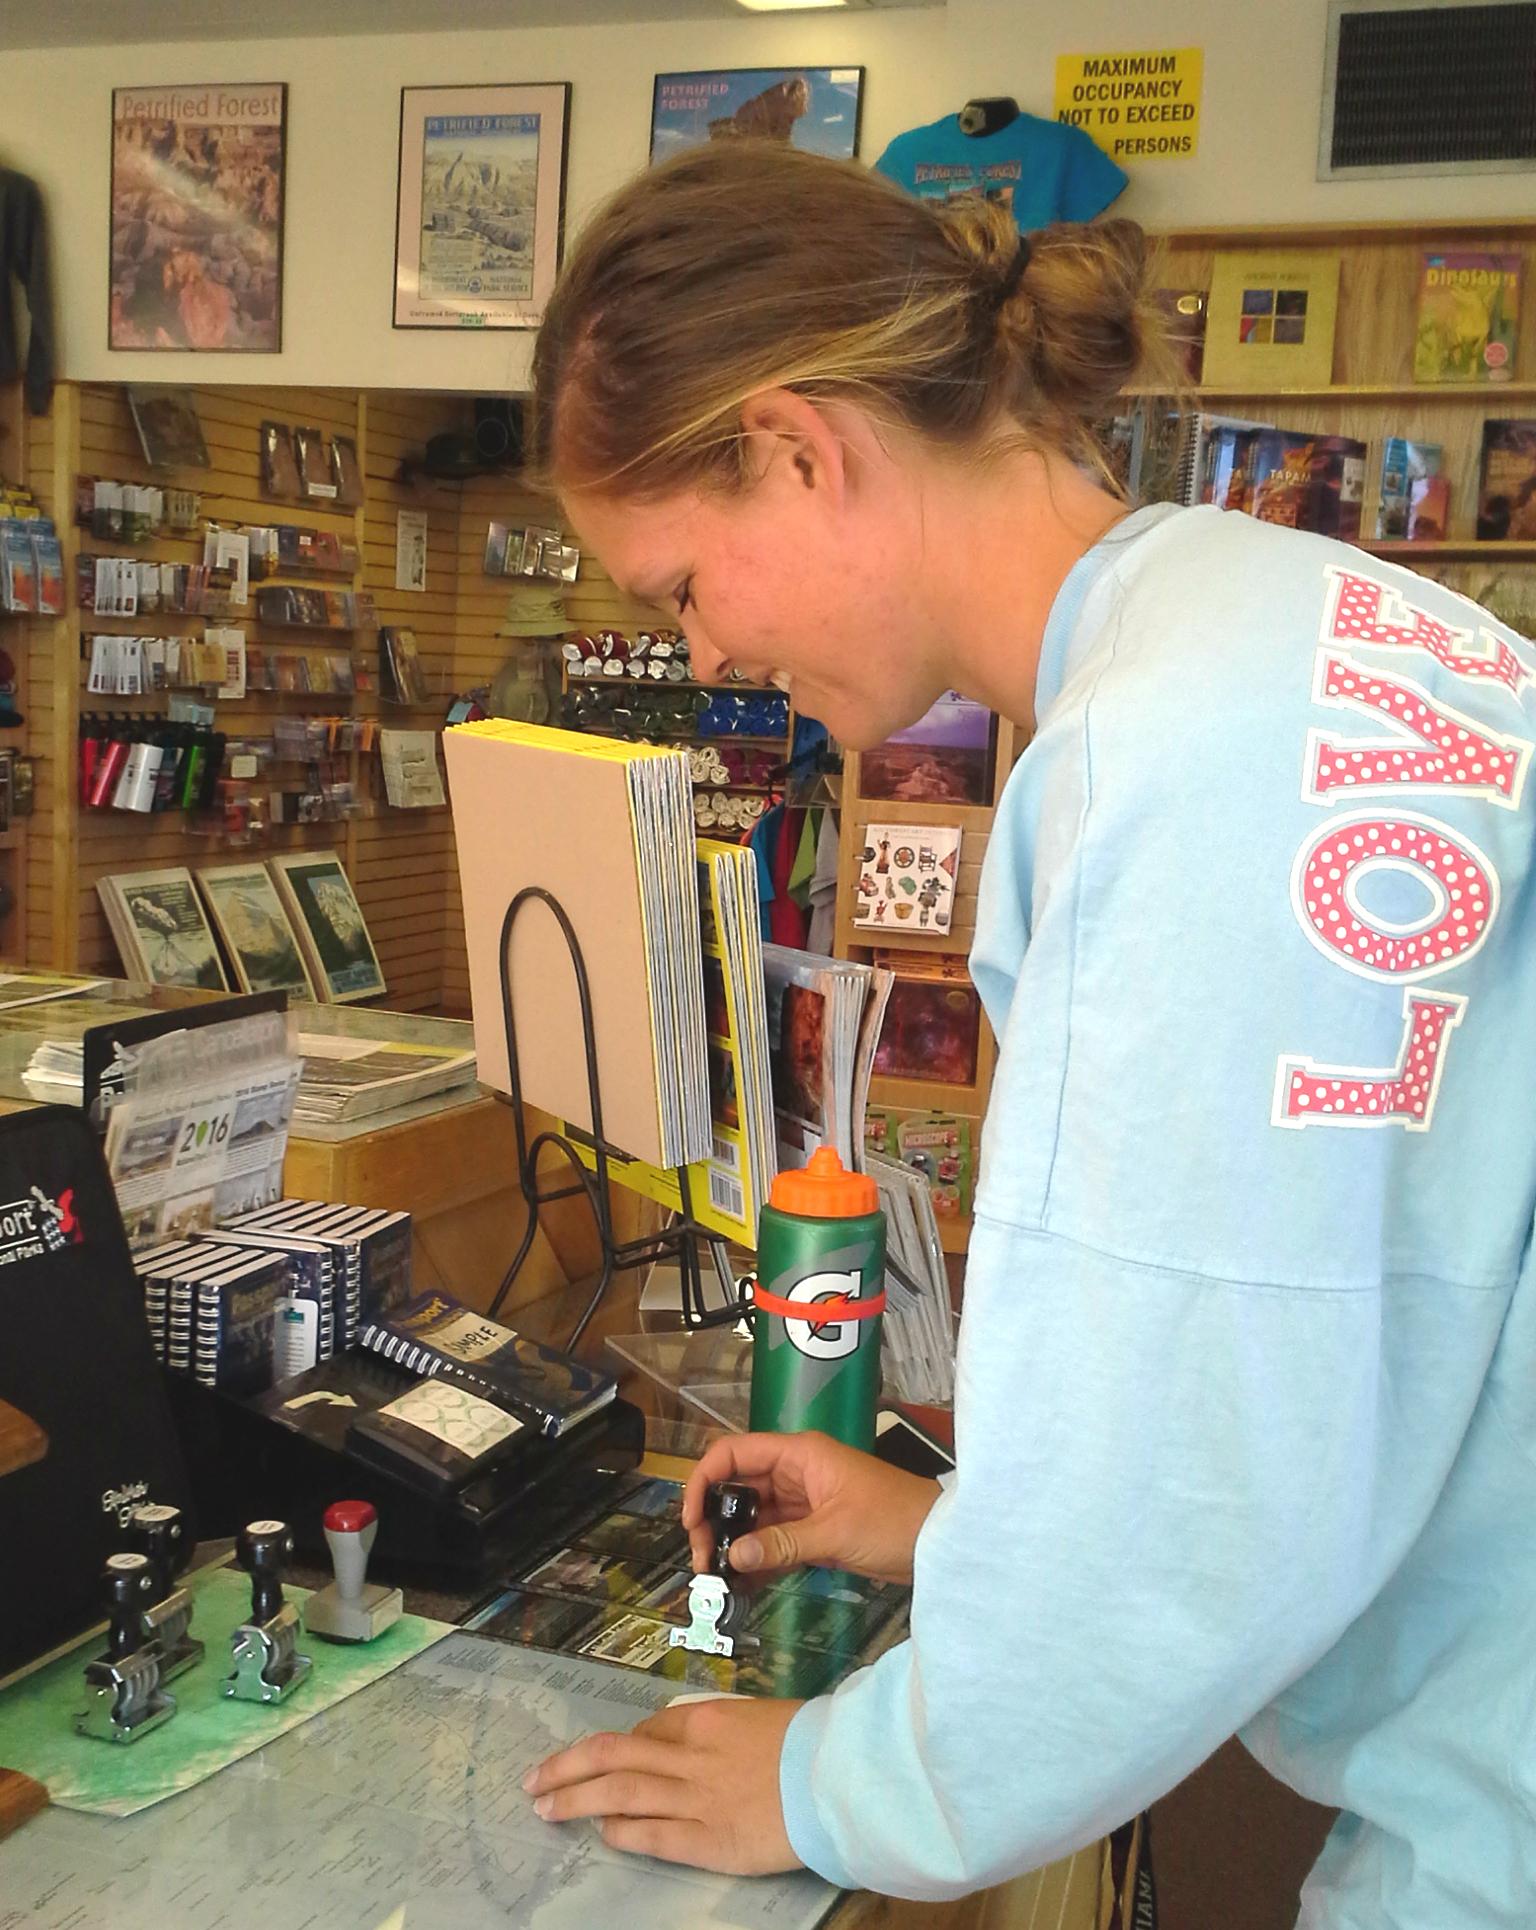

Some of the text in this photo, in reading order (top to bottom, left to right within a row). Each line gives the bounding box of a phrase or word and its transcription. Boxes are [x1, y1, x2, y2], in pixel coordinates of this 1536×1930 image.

[1083, 56, 1176, 77] MAXIMUM
[662, 83, 729, 97] PETRIFIED
[1072, 80, 1183, 102] OCCUPANCY
[122, 94, 278, 119] Petrified Forest
[661, 97, 709, 111] FOREST
[1058, 103, 1196, 126] NOT TO EXCEED
[1114, 136, 1192, 155] PERSONS
[1271, 563, 1536, 1133] LOVE
[0, 1208, 37, 1238] ort
[783, 1269, 862, 1361] G
[1133, 1868, 1153, 1930] IAMI
